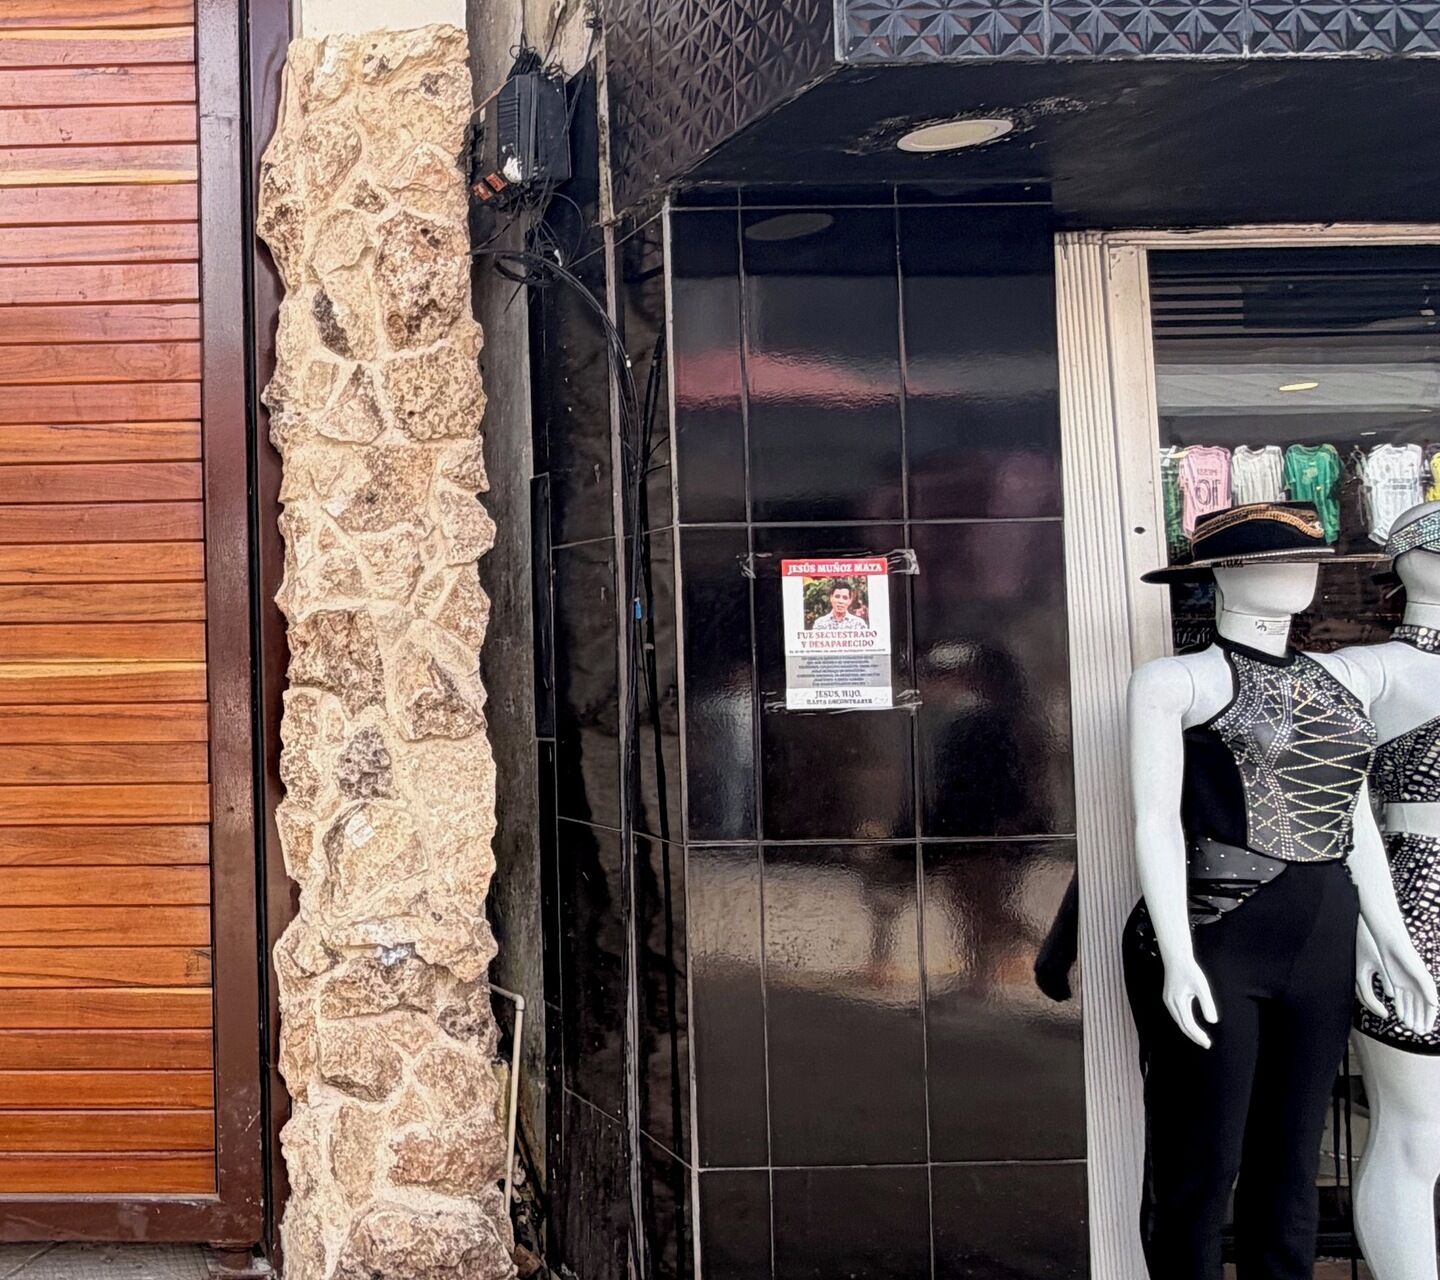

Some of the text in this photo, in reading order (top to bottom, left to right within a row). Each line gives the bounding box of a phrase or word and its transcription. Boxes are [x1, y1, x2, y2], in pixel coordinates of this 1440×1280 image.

[817, 562, 853, 573] MUÑOZ
[797, 630, 877, 640] FUE SECUESTRADO
[809, 639, 874, 648] DESAPARECIDO
